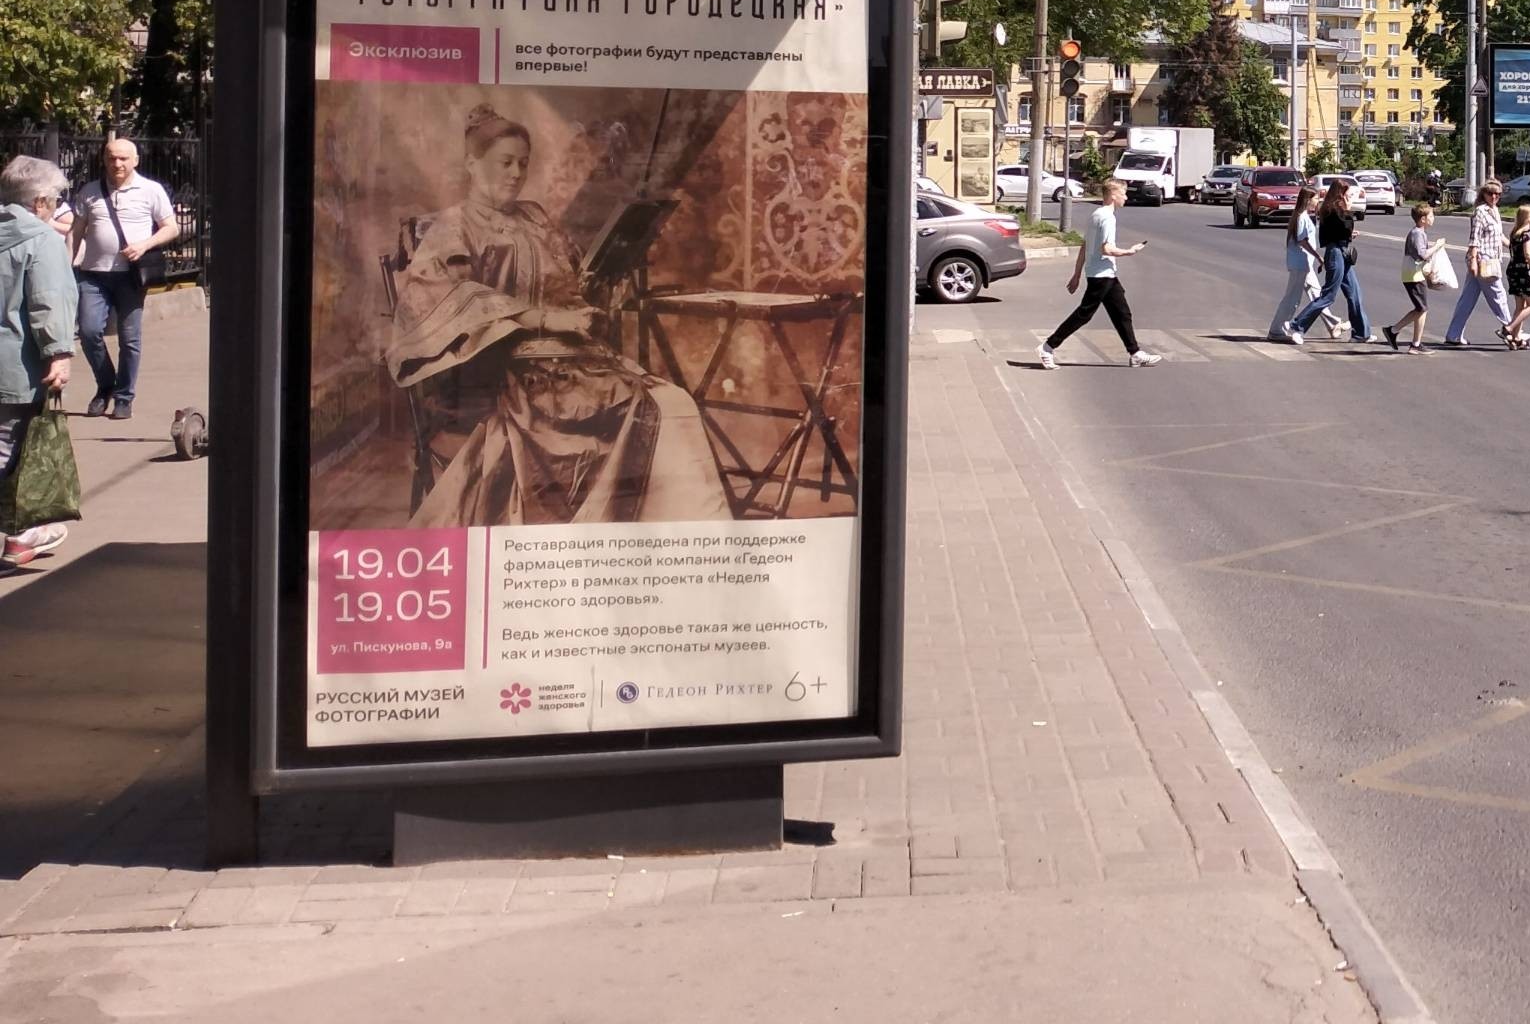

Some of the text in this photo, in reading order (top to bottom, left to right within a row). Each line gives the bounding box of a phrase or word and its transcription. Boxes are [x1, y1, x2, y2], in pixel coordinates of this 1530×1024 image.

[350, 42, 462, 60] Эксклюзив
[515, 42, 803, 63] все фотографии будут представлены
[515, 60, 588, 74] впервые!
[937, 75, 981, 90] ЛАВКА
[504, 534, 806, 552] Реставрация проведена при поддержке
[333, 547, 453, 580] 19.04
[503, 552, 793, 573] фармацевтической компании «Гедеон
[503, 572, 770, 592] Рихтер» в рамках проекта «Неделя
[333, 589, 452, 623] 19.05
[502, 594, 663, 609] женского здоровья».
[502, 619, 828, 642] Ведь женское здоровье такая же ценность,
[331, 638, 453, 655] ул. Пискунова, 9а
[501, 640, 771, 660] как и известные экспонаты музеев.
[316, 685, 465, 705] РУССКИЙ МУЗЕЙ
[538, 683, 575, 692] неделя
[784, 671, 828, 702] 6+
[538, 692, 586, 701] женского
[315, 707, 440, 723] ФОТОГРАФИИ
[538, 701, 585, 711] здоровья
